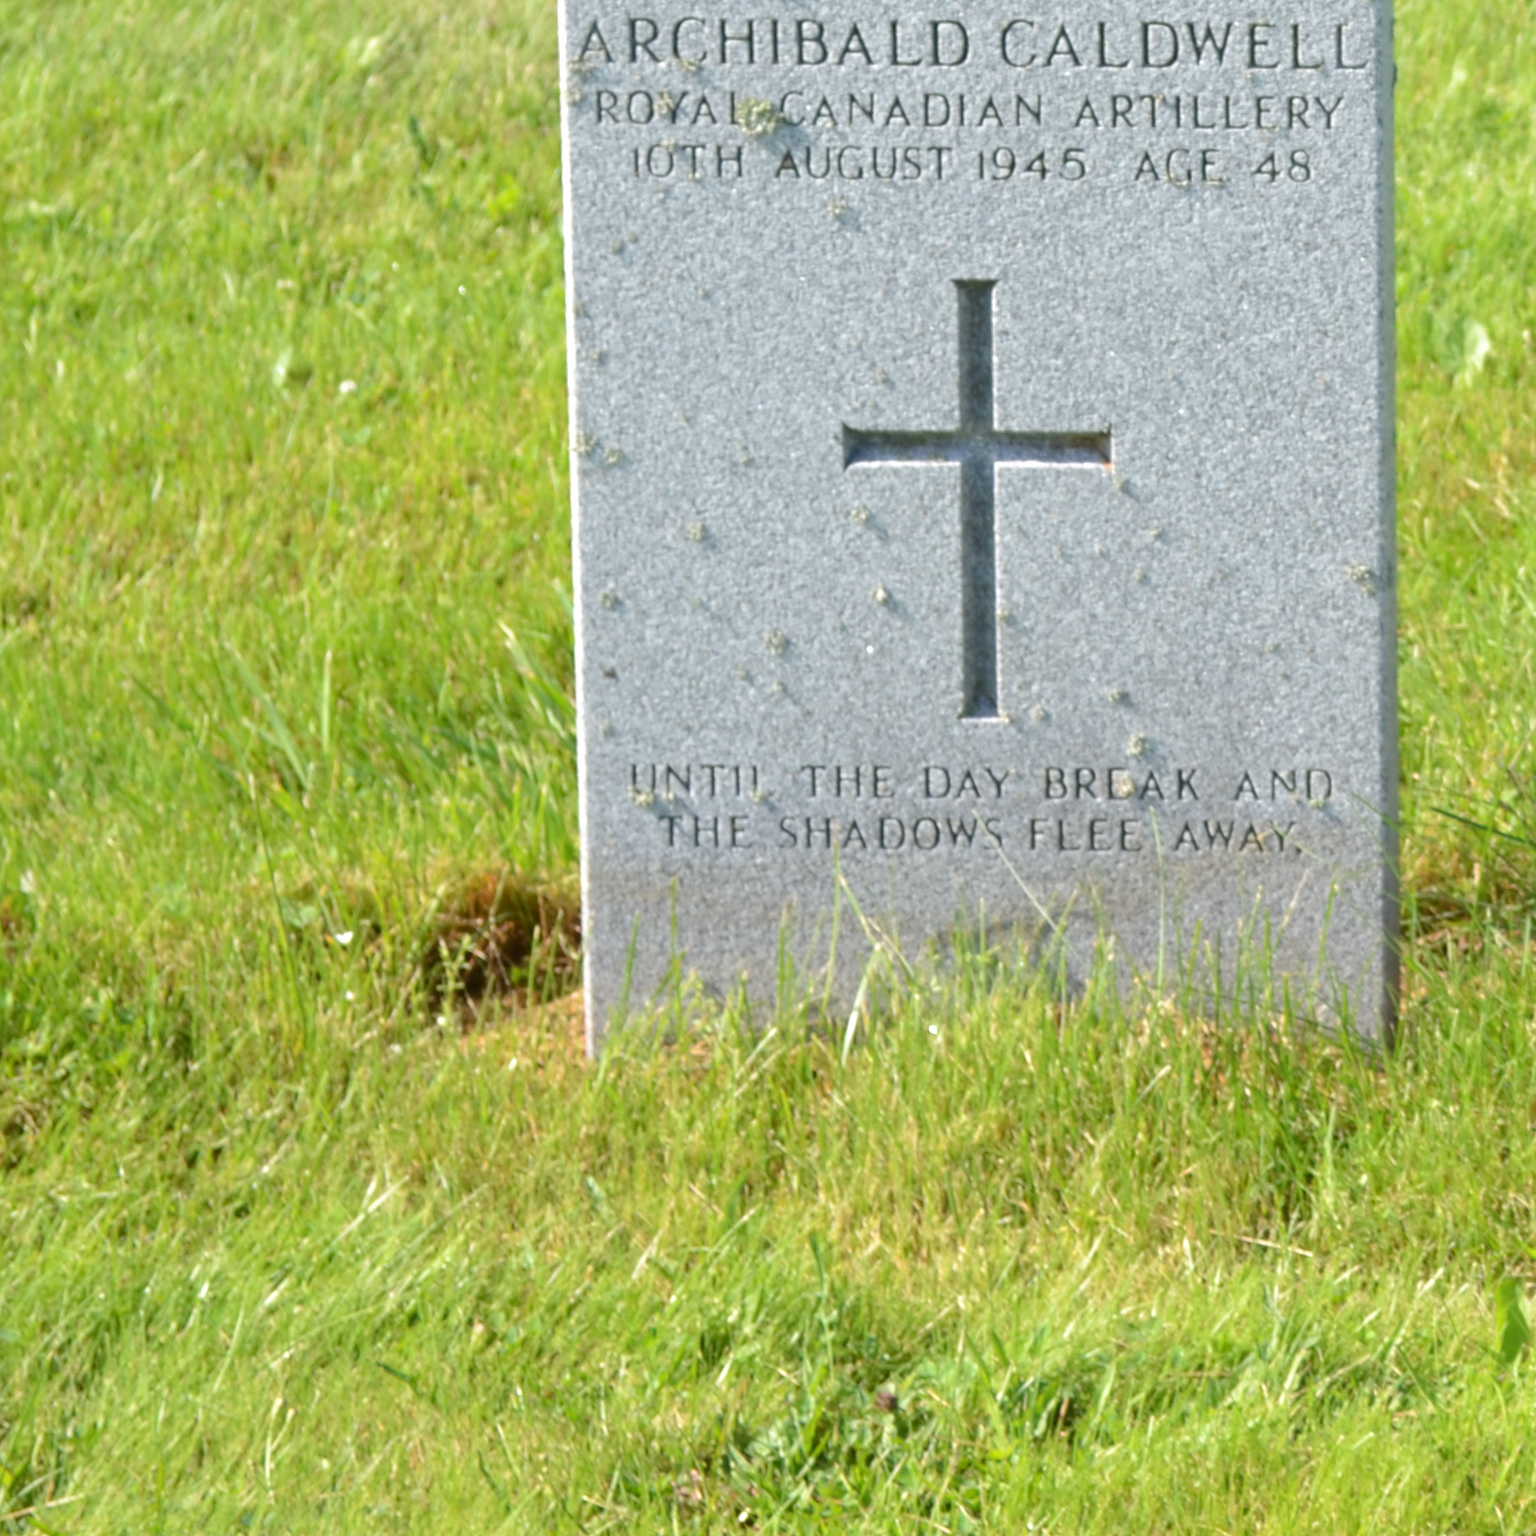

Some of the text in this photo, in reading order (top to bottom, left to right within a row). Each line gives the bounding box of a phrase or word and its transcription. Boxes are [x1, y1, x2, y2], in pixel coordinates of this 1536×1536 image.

[577, 17, 1370, 71] ARCHIBALD CALDWELL
[595, 90, 1345, 132] ROYAL CANADIAN ARTILLERY
[632, 143, 1313, 184] 10TH AUGUST 1945 AGE 48
[629, 763, 1334, 803] UNTIL THE DAY BREAK AND
[658, 814, 751, 848] THE
[778, 815, 1004, 852] SHADOWS
[1029, 817, 1143, 853] FLEE
